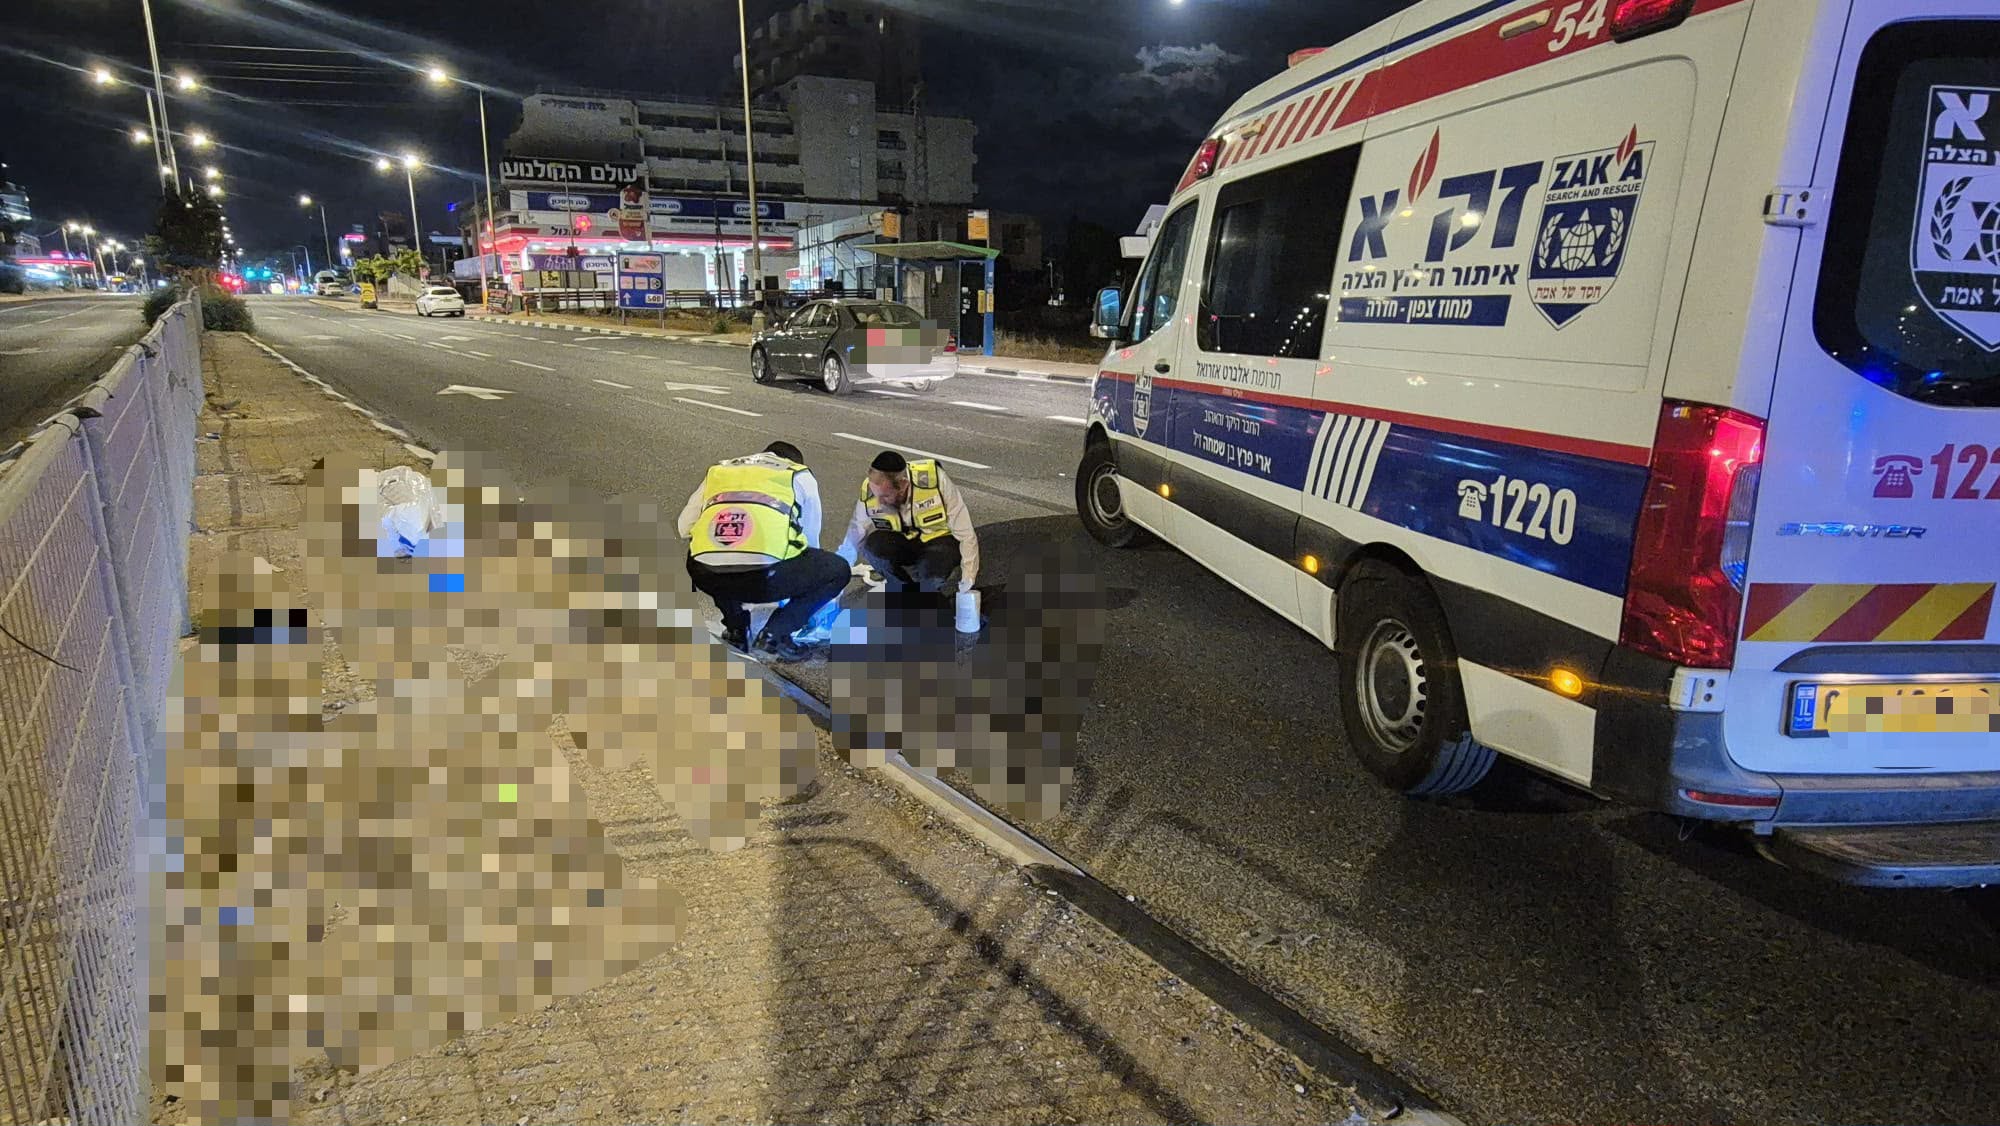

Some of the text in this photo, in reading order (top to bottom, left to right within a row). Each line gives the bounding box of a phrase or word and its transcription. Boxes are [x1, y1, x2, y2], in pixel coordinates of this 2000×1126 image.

[1548, 0, 1608, 52] 54
[1928, 145, 1987, 162] הצלה
[504, 160, 637, 182] עולם הקולנוע
[1546, 182, 1642, 202] SEARCH AND RESCUE
[1342, 271, 1387, 290] הצלה
[1452, 264, 1520, 287] איתור
[1535, 281, 1601, 299] חסד של אמת
[1941, 286, 1984, 305] אמת
[1366, 300, 1398, 318] חדרה
[1407, 299, 1435, 323] צפון
[1438, 299, 1472, 319] מחוז
[1222, 363, 1249, 384] אלברט
[1251, 369, 1281, 390] תרומת
[1226, 415, 1240, 432] היקר
[1242, 419, 1260, 436] החבר
[1203, 436, 1225, 456] שמחה
[1227, 443, 1235, 463] בן
[1237, 446, 1253, 467] פרץ
[1255, 453, 1272, 474] ארי
[1490, 475, 1577, 545] 1220
[1799, 699, 1812, 716] IL
